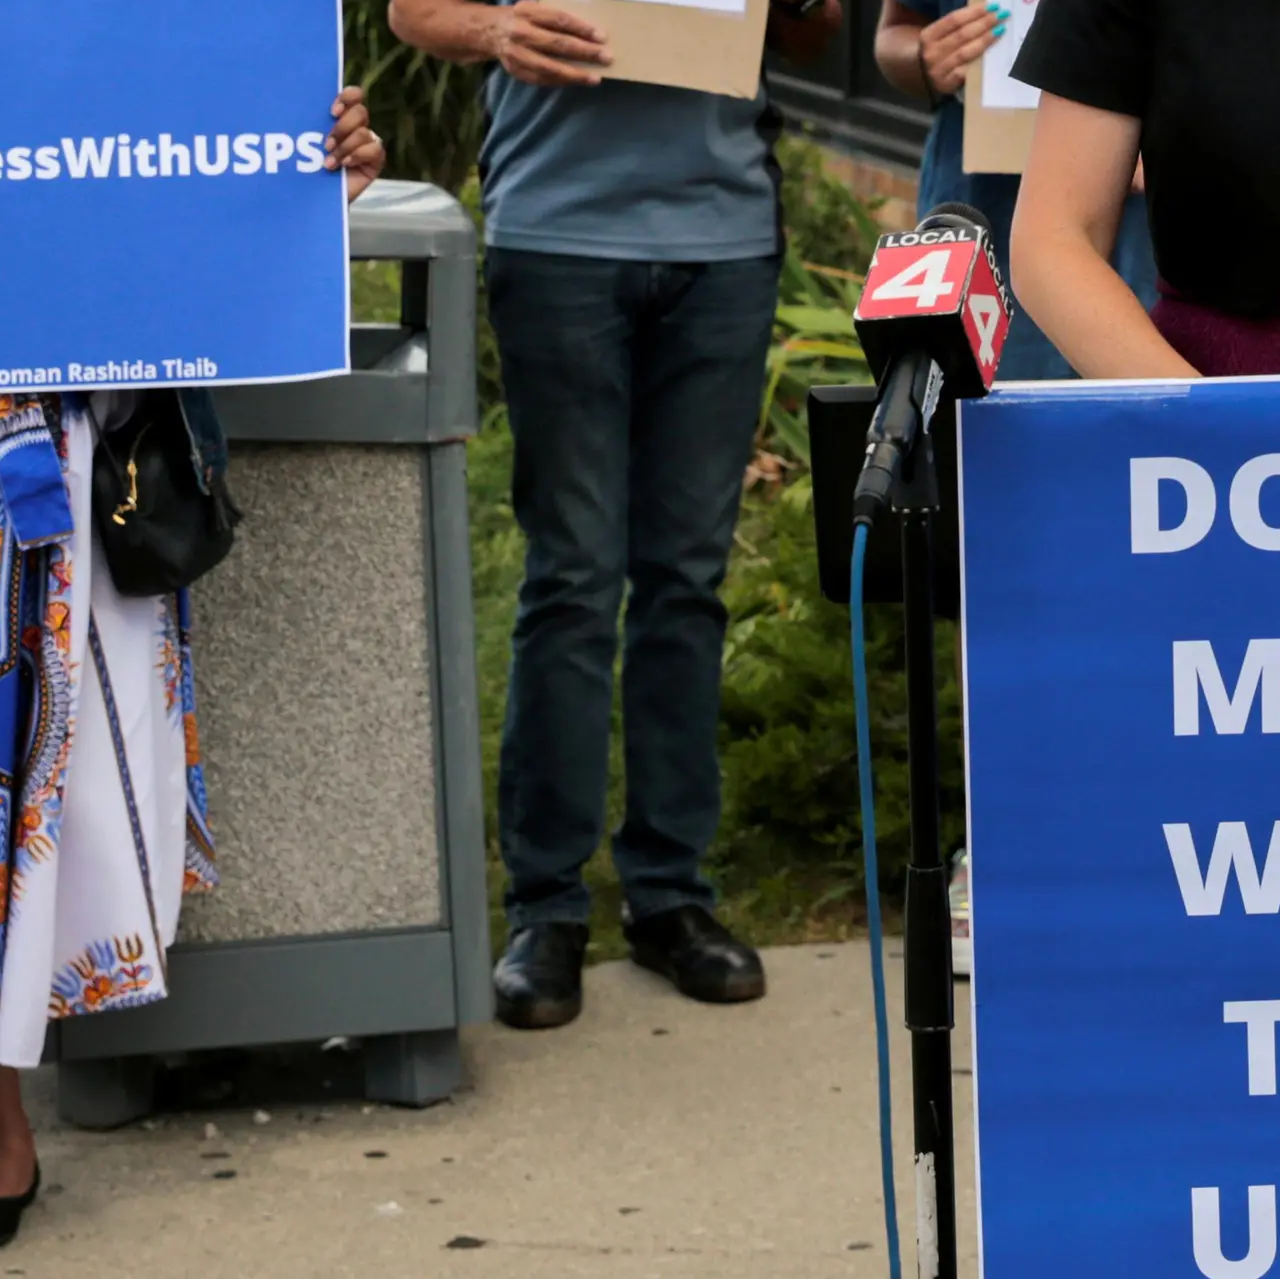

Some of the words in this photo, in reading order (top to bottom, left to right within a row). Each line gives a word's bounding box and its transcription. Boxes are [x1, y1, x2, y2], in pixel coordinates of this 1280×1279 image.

[886, 227, 972, 248] LOCAL
[872, 249, 955, 308] 4
[968, 294, 1001, 367] 4
[67, 360, 157, 383] Rashida
[161, 356, 218, 380] Tlaib
